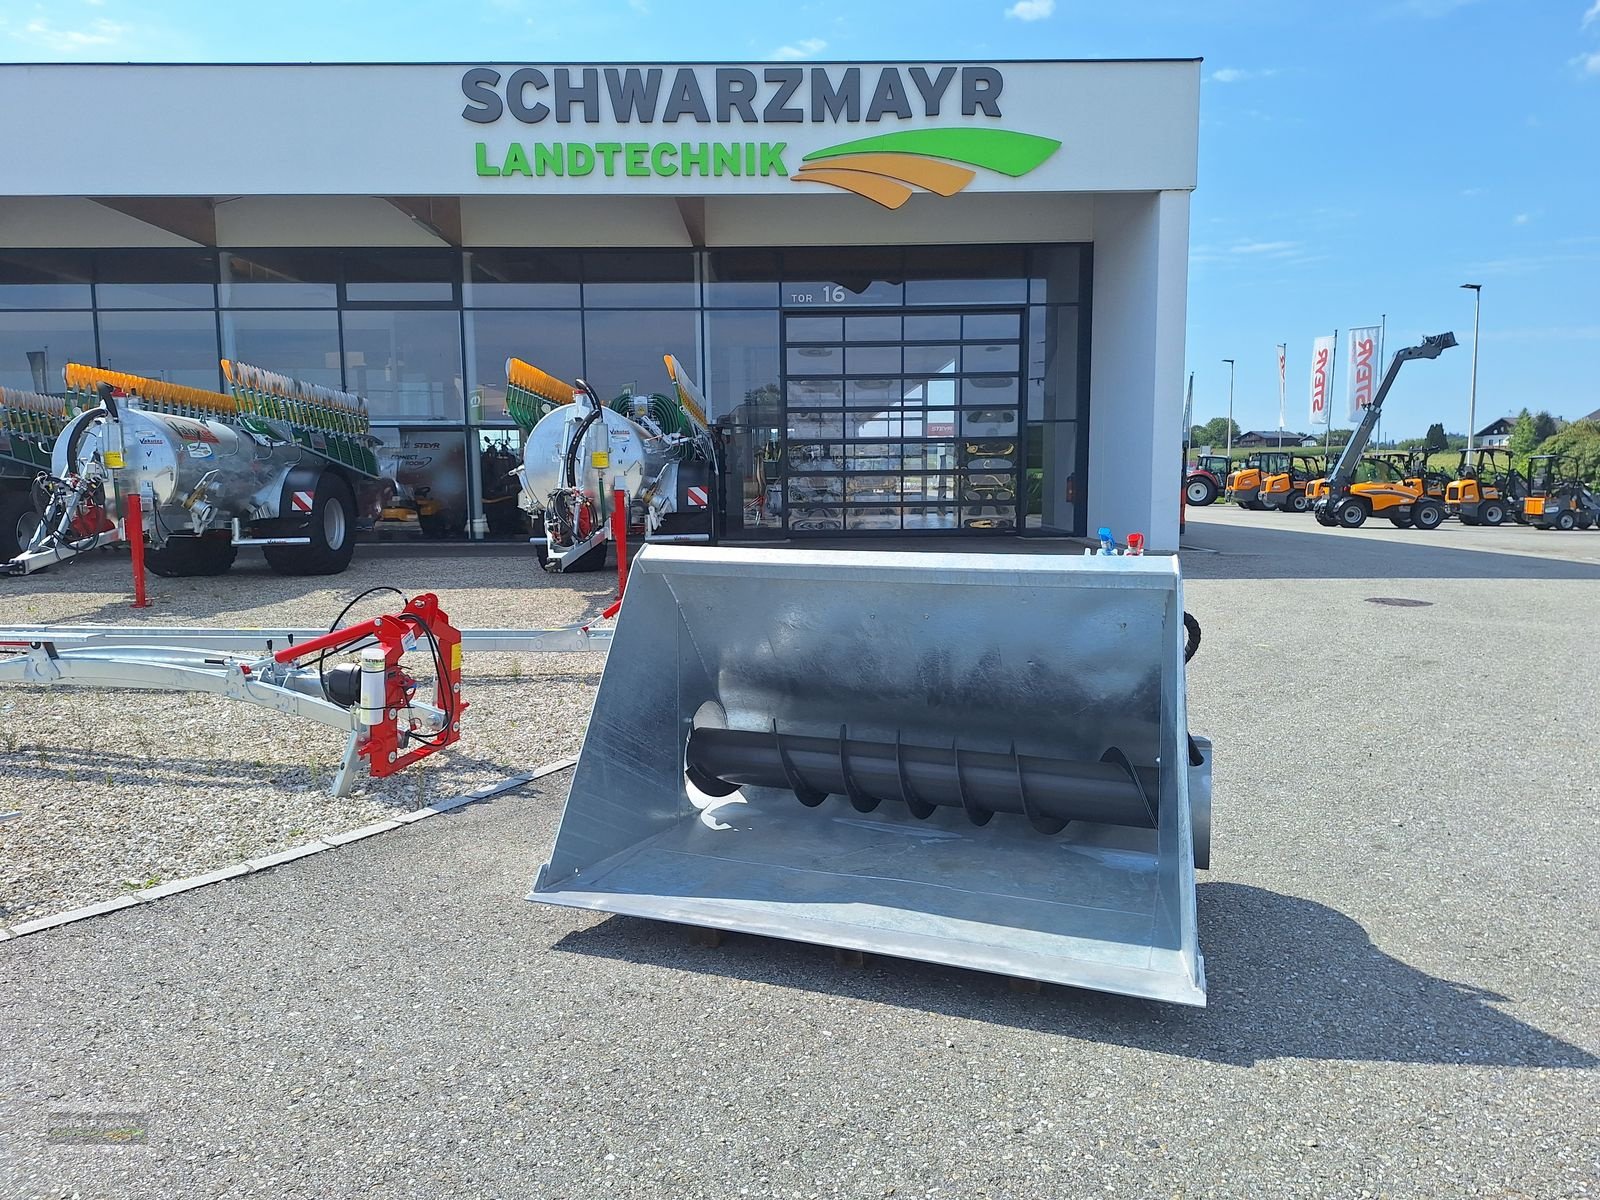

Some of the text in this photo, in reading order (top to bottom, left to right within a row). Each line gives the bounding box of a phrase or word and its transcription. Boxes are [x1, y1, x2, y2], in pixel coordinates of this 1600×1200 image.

[461, 66, 1003, 124] SCHWARZMAYR
[475, 142, 789, 177] LANDTECHNIK
[791, 285, 846, 303] TOR 16
